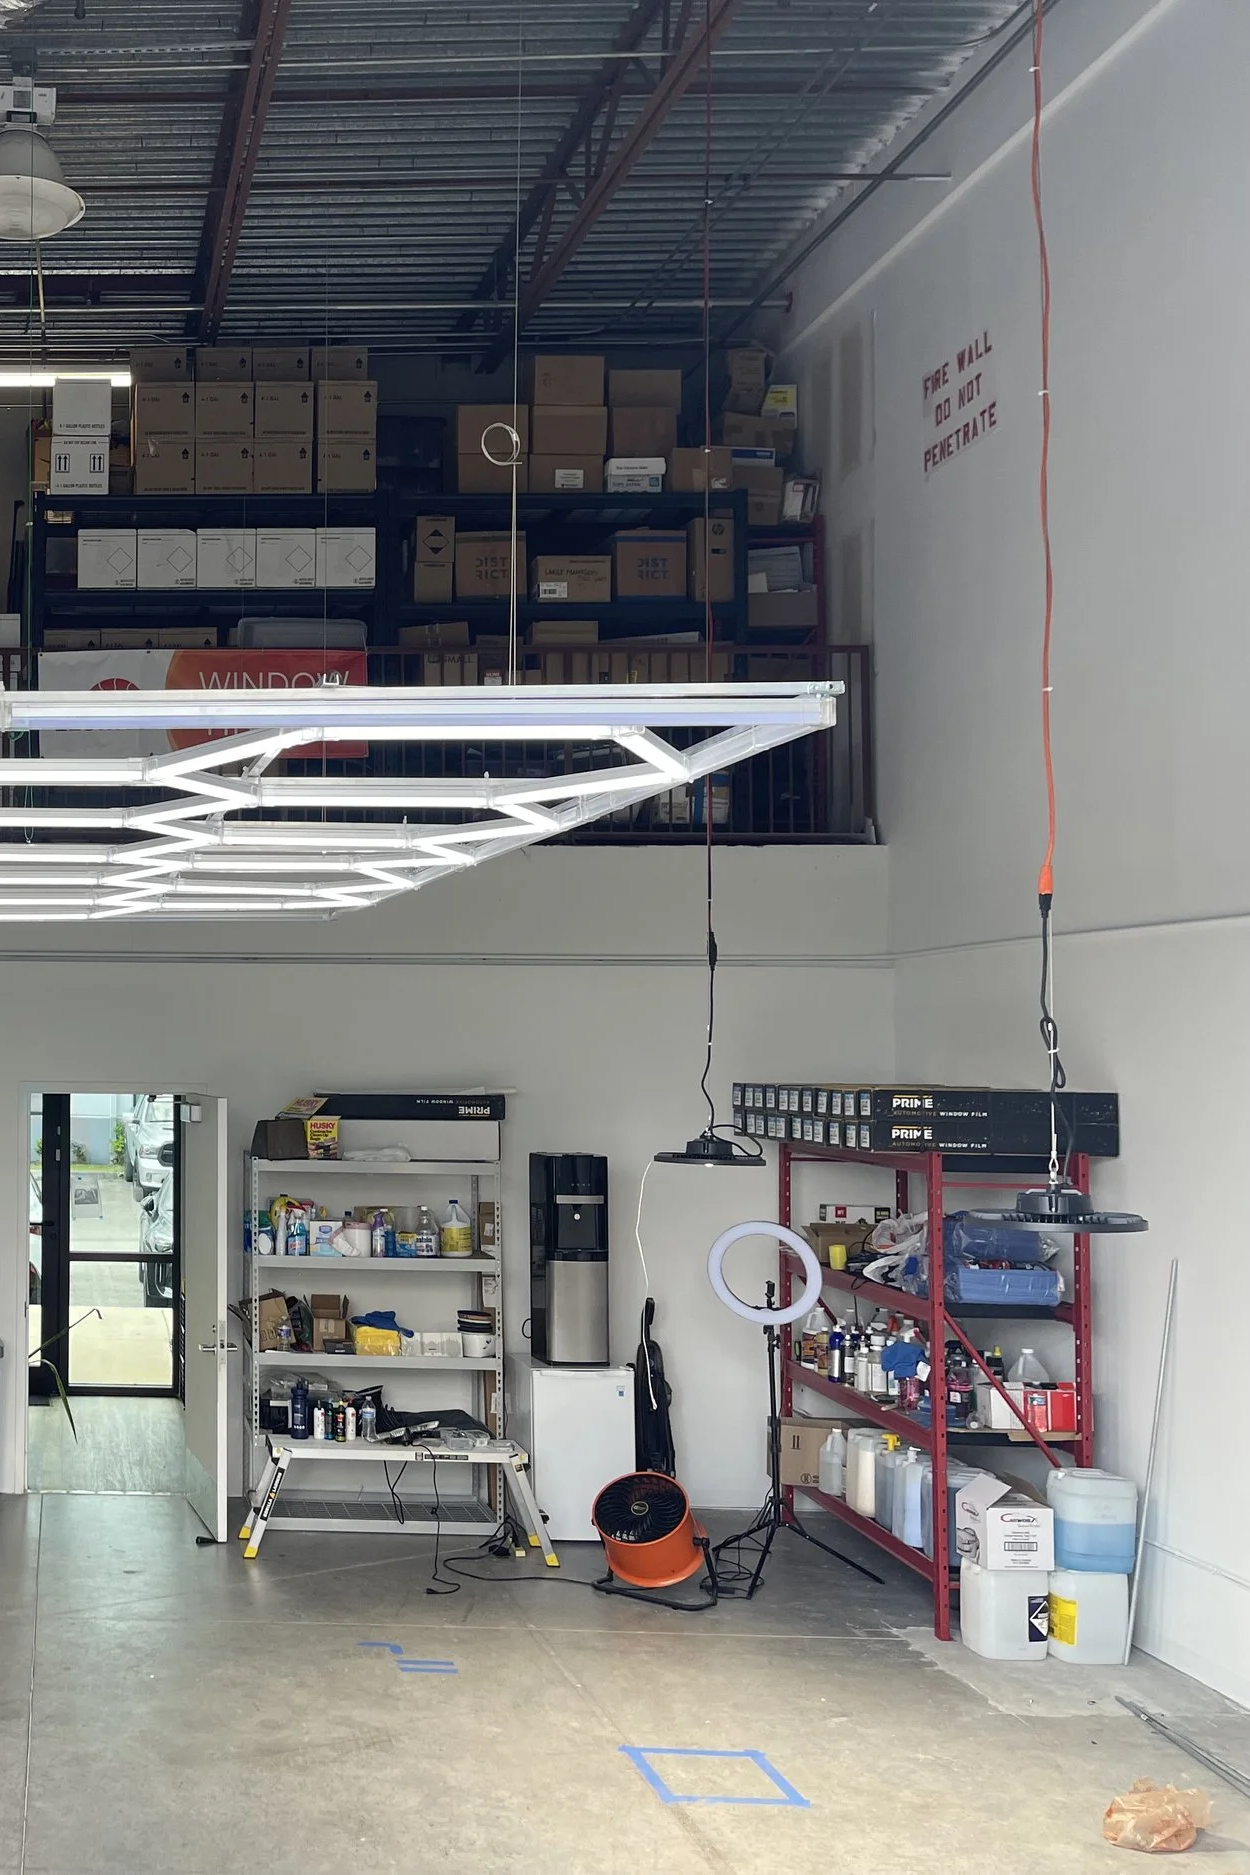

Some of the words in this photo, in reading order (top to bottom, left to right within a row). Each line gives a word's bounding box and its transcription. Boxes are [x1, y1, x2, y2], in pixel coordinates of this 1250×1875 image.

[924, 362, 949, 400] FIRE
[957, 331, 992, 373] WALL
[936, 397, 951, 427] DO
[958, 373, 982, 410] NOT
[924, 401, 997, 472] PENETRATE
[892, 1098, 934, 1108] PRIME
[458, 1106, 490, 1115] PRIME
[310, 1122, 335, 1130] HUSKY
[891, 1129, 933, 1139] PRIME
